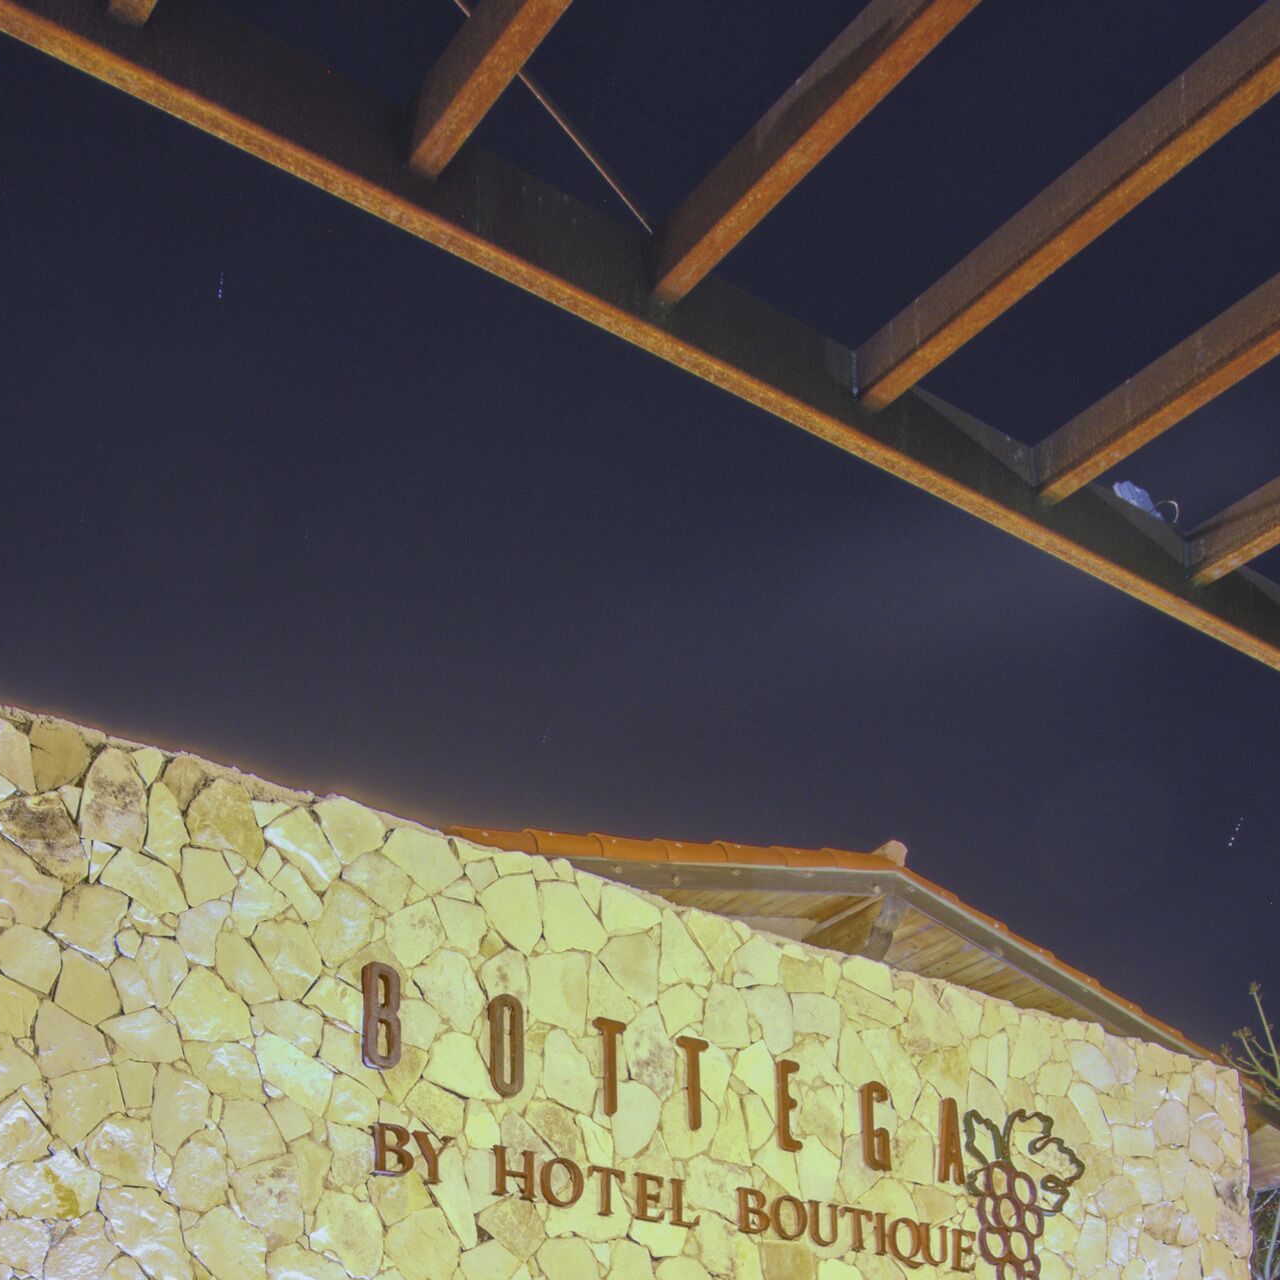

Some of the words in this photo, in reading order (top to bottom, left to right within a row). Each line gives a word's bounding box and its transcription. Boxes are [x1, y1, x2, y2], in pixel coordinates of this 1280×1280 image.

[361, 960, 966, 1186] BOTTEGA
[370, 1122, 456, 1185] BY
[491, 1144, 701, 1229] HOTEL
[735, 1186, 977, 1273] BOUTIQUE
